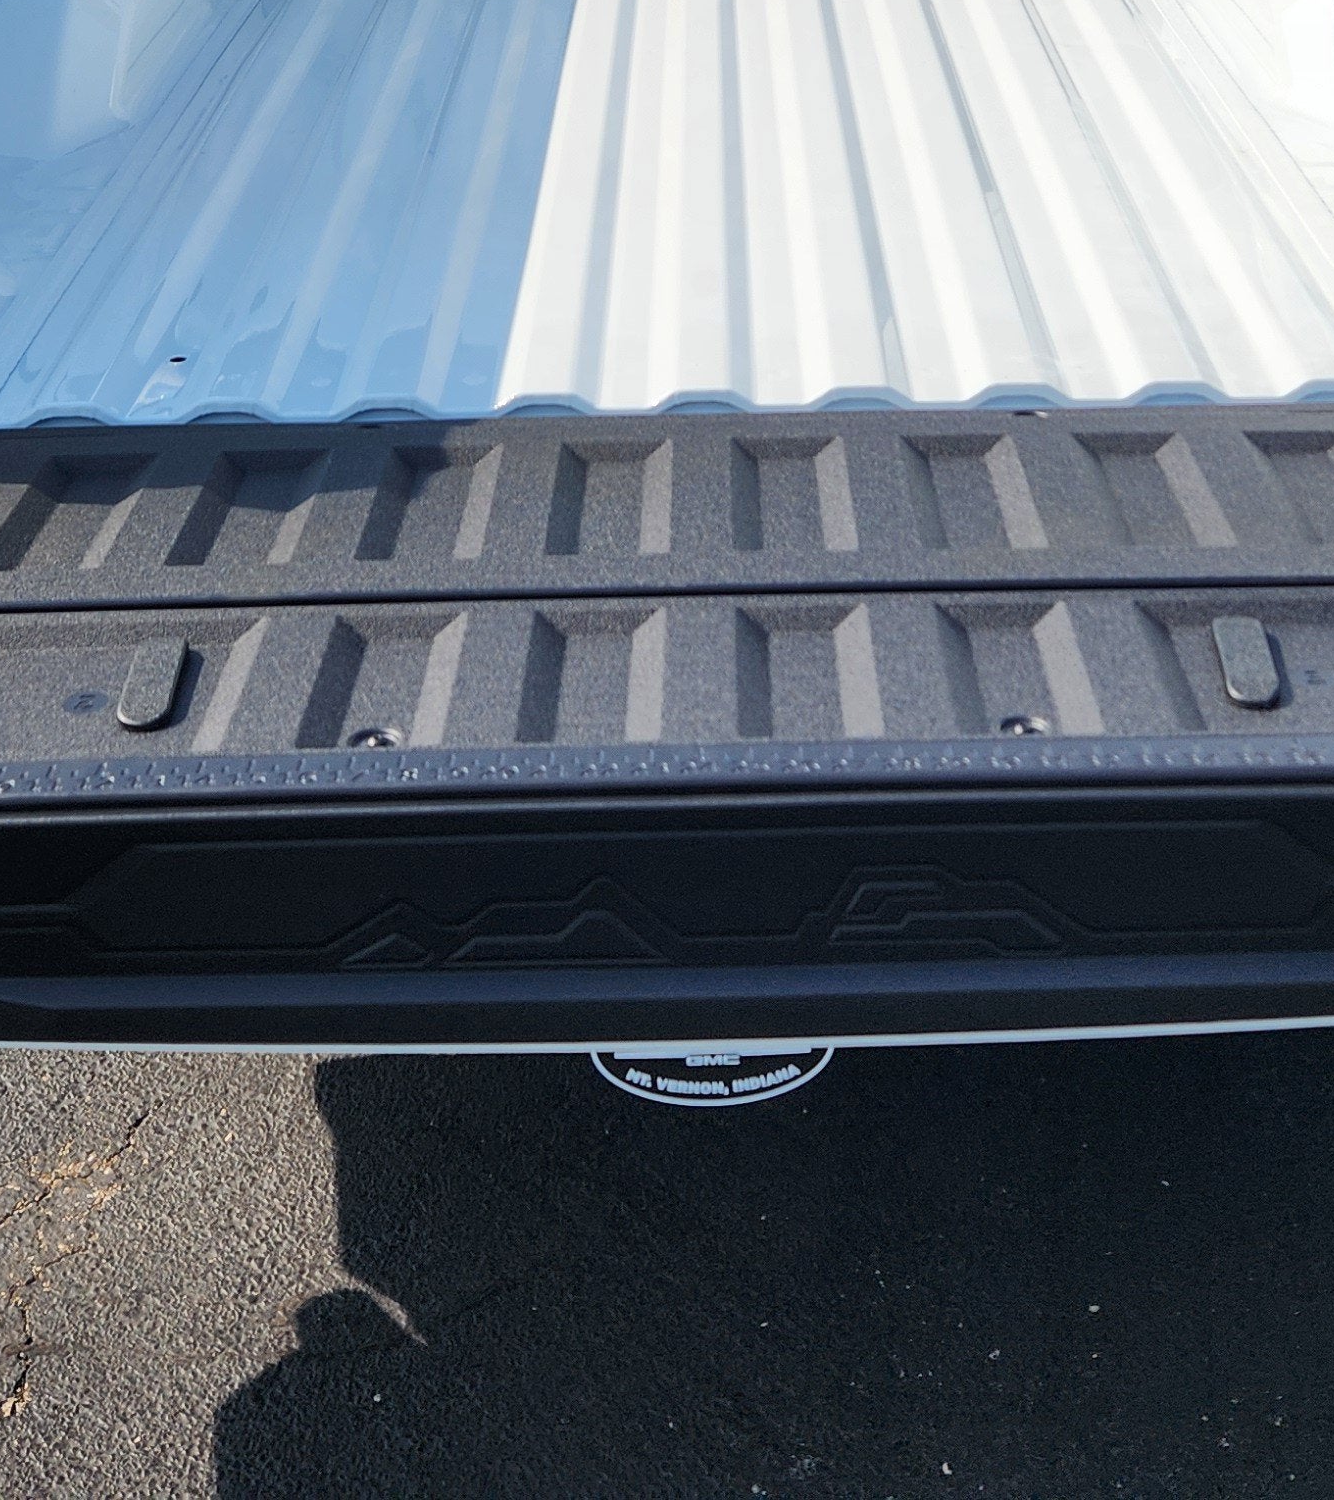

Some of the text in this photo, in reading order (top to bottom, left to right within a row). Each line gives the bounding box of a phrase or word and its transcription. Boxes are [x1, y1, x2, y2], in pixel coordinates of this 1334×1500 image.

[686, 1055, 741, 1067] GMC
[625, 1063, 802, 1096] MT. VERNON, INDIANA
